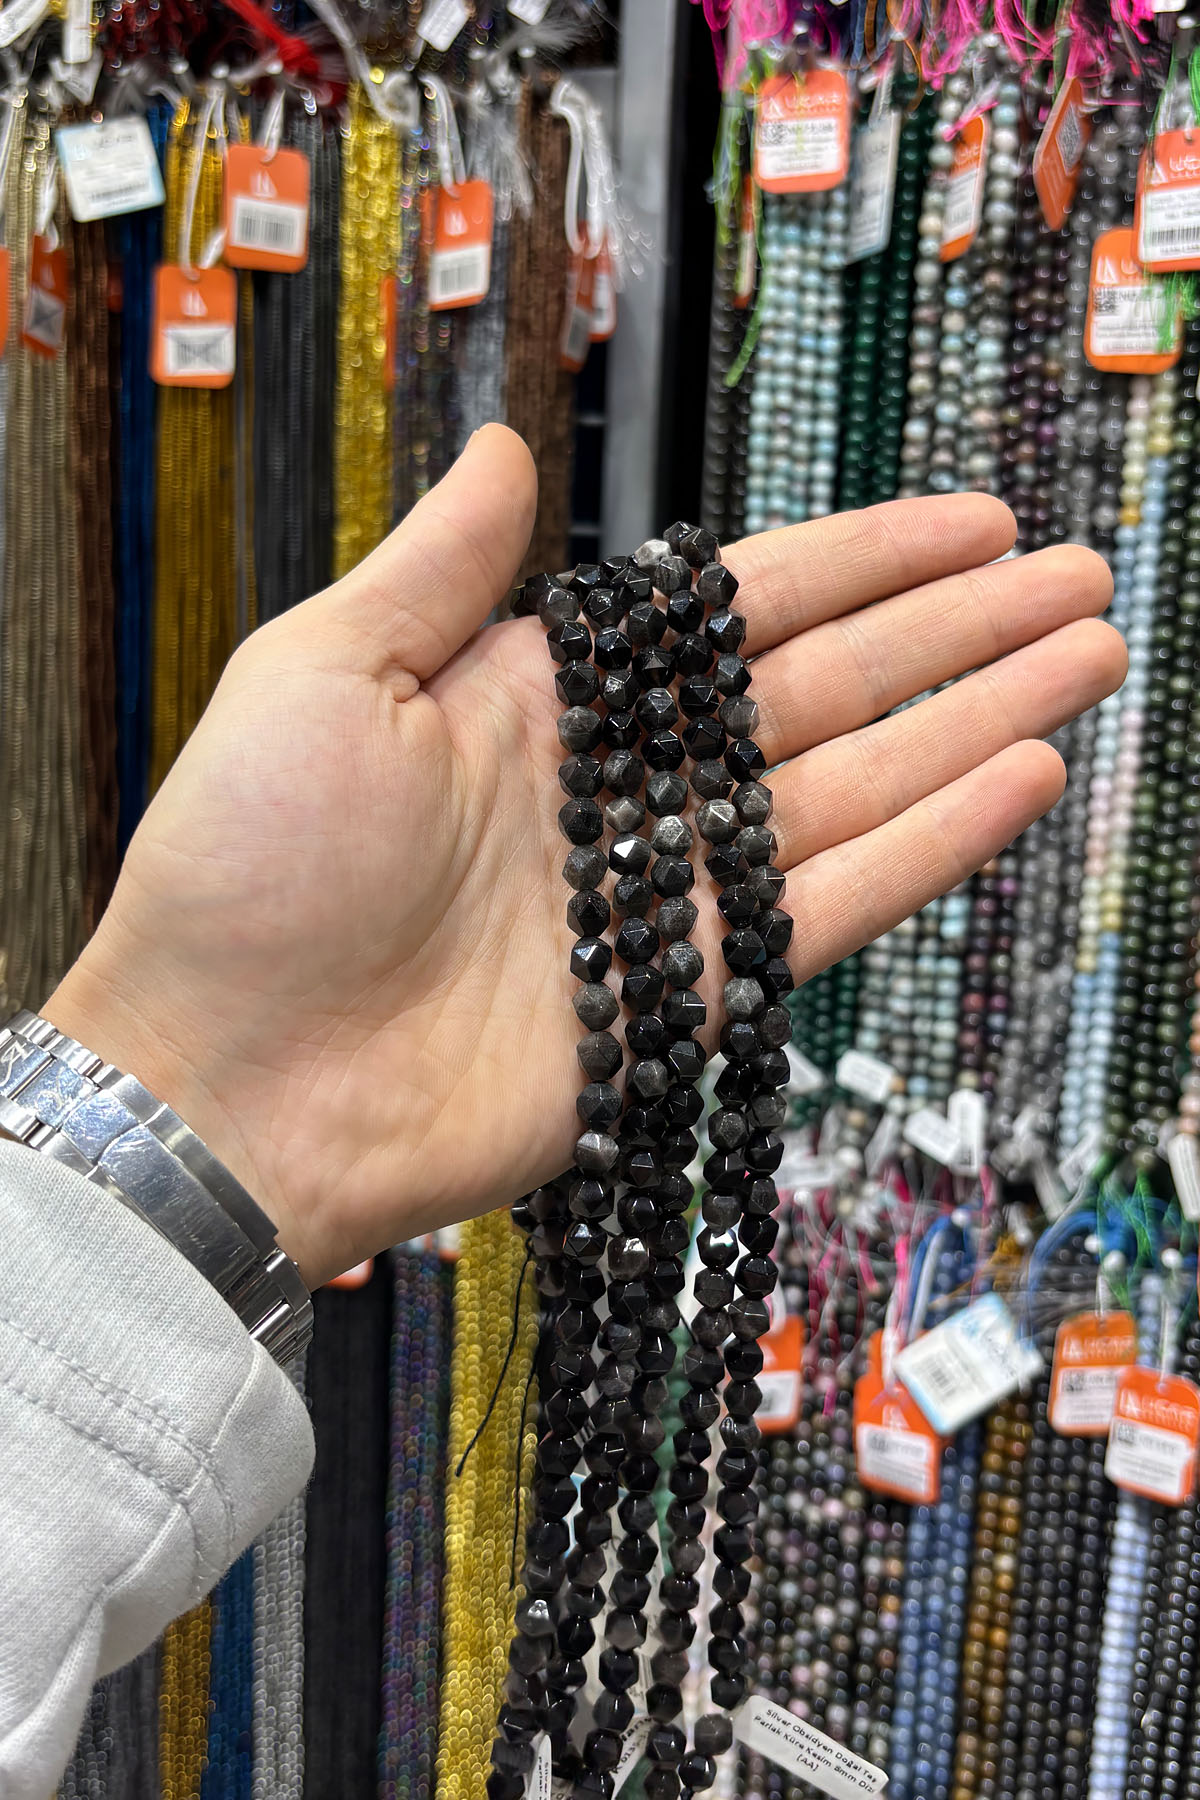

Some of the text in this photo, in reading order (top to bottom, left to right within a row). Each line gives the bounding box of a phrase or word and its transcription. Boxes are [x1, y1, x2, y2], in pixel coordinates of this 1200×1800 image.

[754, 1715, 781, 1735] Parlak
[766, 1709, 791, 1726] Silver
[792, 1725, 833, 1752] Obsidyen
